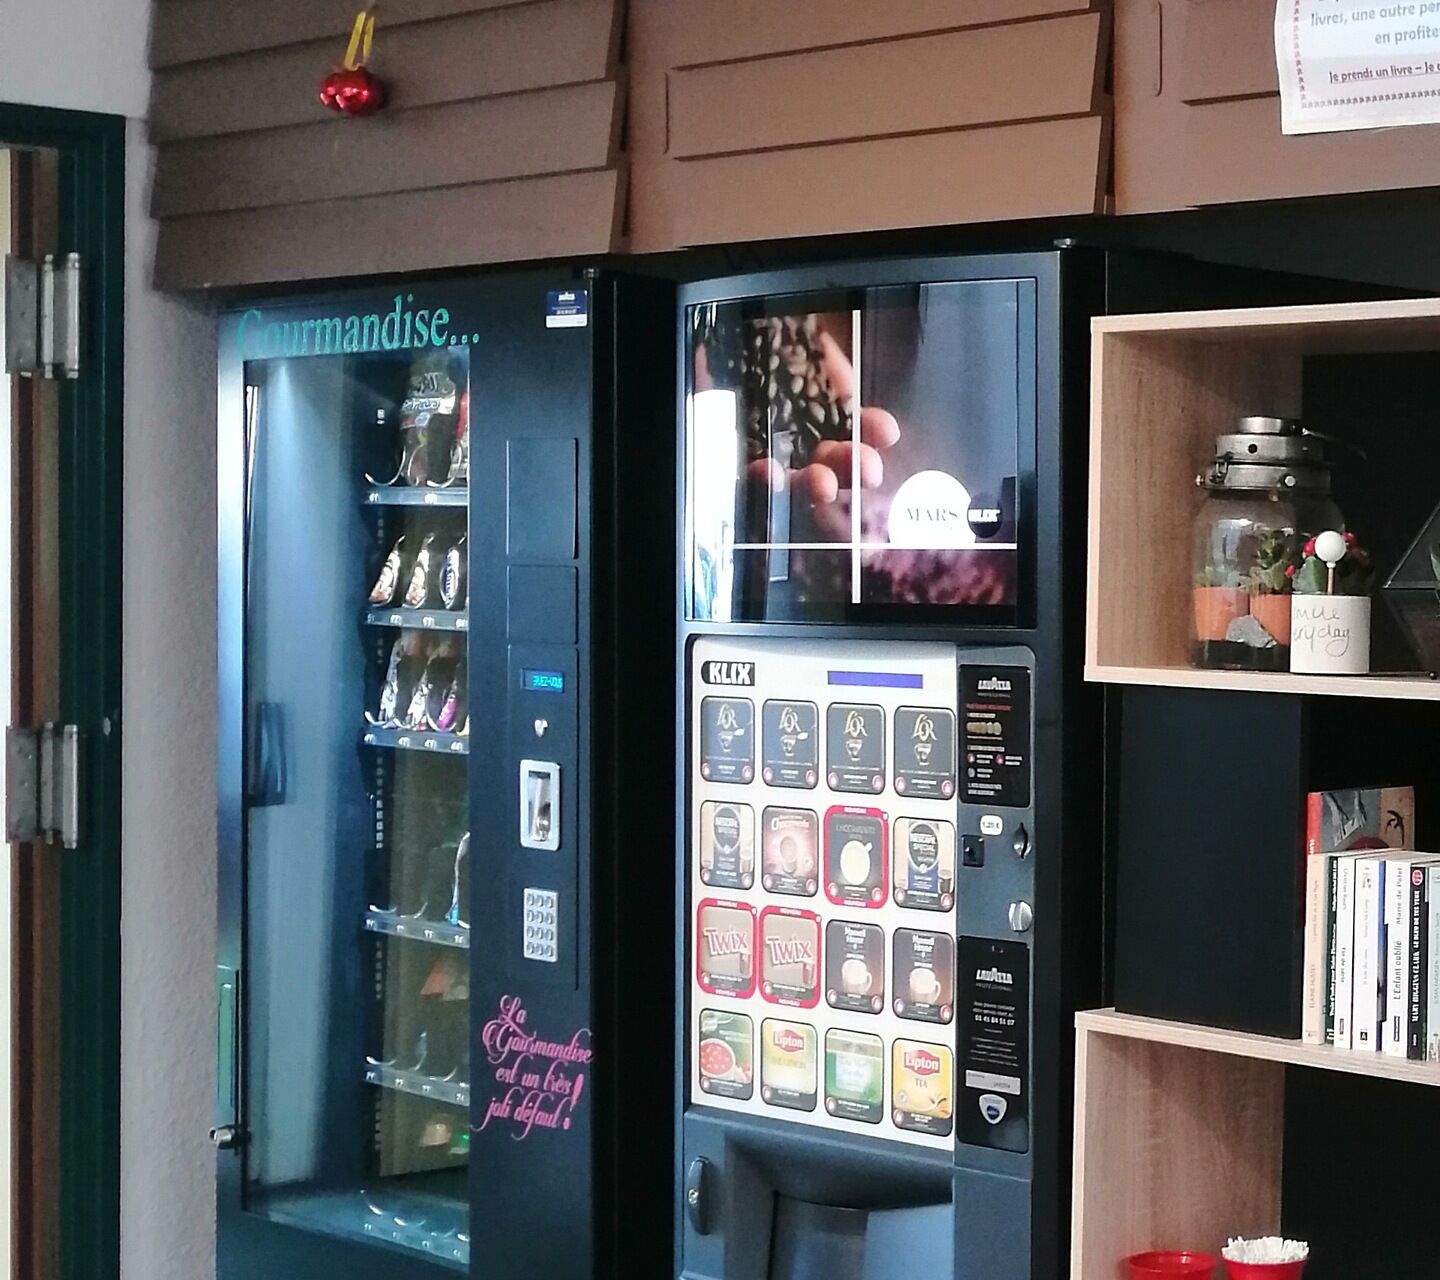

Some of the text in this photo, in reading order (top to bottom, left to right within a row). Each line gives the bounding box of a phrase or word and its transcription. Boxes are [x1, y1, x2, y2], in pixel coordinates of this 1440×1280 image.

[1311, 11, 1348, 27] livres,
[1351, 9, 1376, 21] une
[1379, 3, 1416, 19] autre
[1374, 32, 1391, 44] en
[1341, 67, 1373, 85] prends
[1376, 67, 1388, 78] un
[1390, 63, 1412, 77] livre
[708, 662, 752, 685] KLIX
[1393, 940, 1402, 1000] L'Enfant oublié
[905, 1052, 939, 1071] Lipton
